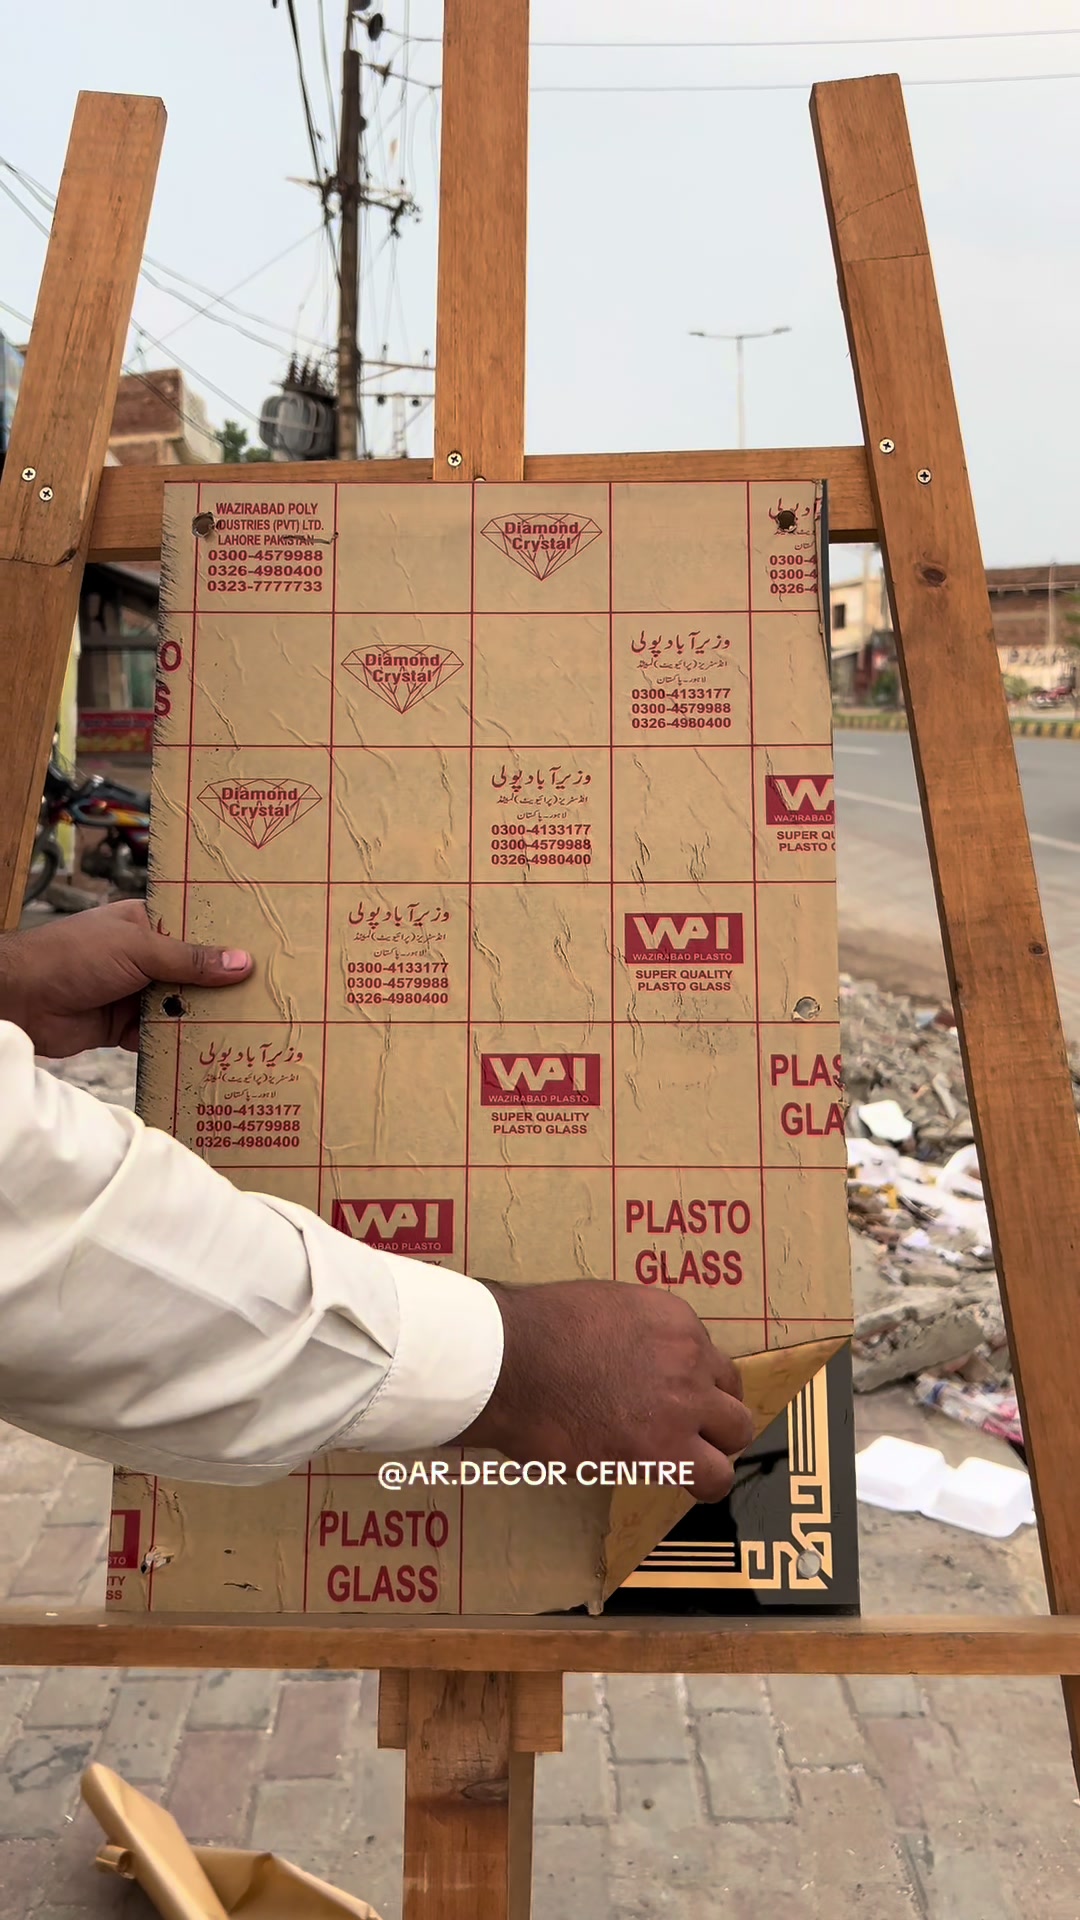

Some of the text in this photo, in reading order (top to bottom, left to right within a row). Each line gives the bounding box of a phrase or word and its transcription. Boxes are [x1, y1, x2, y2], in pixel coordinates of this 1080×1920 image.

[216, 503, 318, 514] WAZIRABAD POLY
[217, 519, 325, 533] DUSTRIES (PVT) LTD.
[504, 522, 579, 534] Diamond
[218, 535, 315, 546] LAHORE PAKISTAN
[512, 537, 571, 552] Crystal
[208, 550, 323, 561] 0300-4579988
[207, 565, 323, 577] 0326-4980400
[207, 581, 323, 592] 0323-7777733
[365, 654, 440, 666] Diamond
[372, 669, 432, 685] Crystal
[631, 688, 731, 699] 0300-4133177
[631, 703, 731, 714] 0300-4579988
[631, 717, 732, 729] 0326-4980400
[222, 787, 298, 800] Diamond
[229, 804, 290, 819] Crystal
[773, 814, 833, 822] WAZIRABAD
[491, 824, 591, 835] 0300-4133177
[776, 830, 818, 840] SUPER
[491, 839, 592, 850] 0300-4579988
[779, 842, 828, 852] PLASTO
[491, 854, 592, 865] 0326-4980400
[632, 953, 733, 961] WAZIRABAD PLASTO
[347, 962, 449, 974] 0300-4133177
[635, 969, 733, 979] SUPER QUALITY
[347, 977, 449, 989] 0300-4579988
[638, 981, 731, 992] PLASTO GLASS
[347, 992, 449, 1004] 0326-4980400
[488, 1095, 590, 1103] WAZIRABAD PLASTO
[197, 1104, 302, 1116] 0300-4133177
[491, 1112, 590, 1122] SUPER QUALITY
[196, 1120, 301, 1132] 0300-4579988
[493, 1124, 588, 1135] PLASTO GLASS
[195, 1136, 300, 1148] 0326-4980400
[626, 1199, 751, 1234] PLASTO
[401, 1242, 441, 1250] PLASTO
[635, 1249, 743, 1285] GLASS
[319, 1510, 449, 1548] PLASTO
[327, 1564, 439, 1604] GLASS
